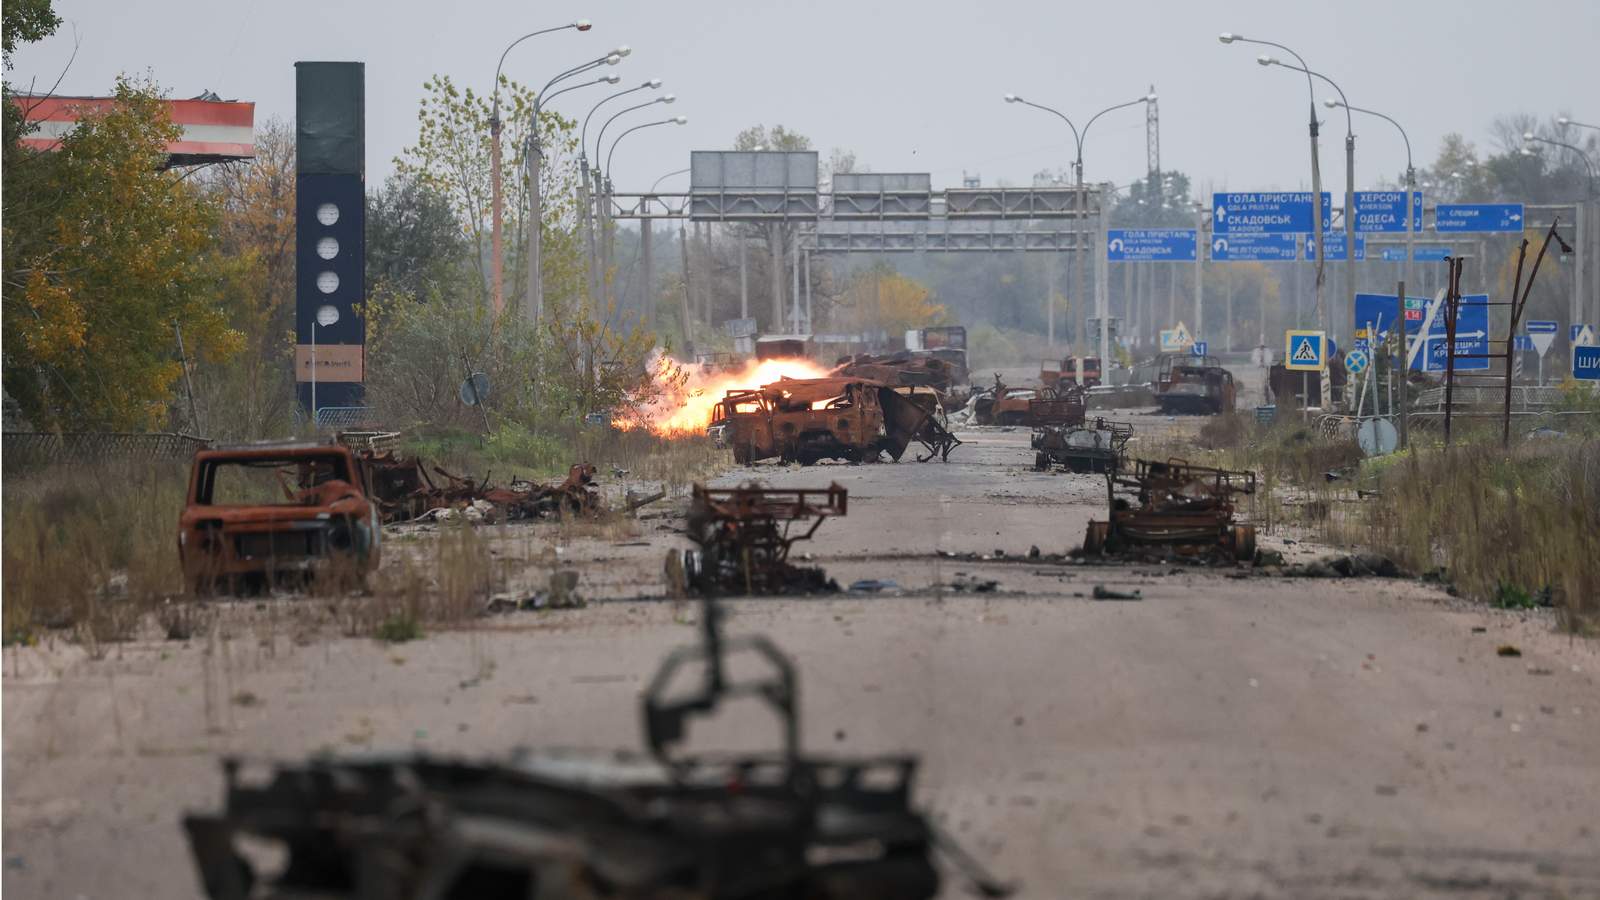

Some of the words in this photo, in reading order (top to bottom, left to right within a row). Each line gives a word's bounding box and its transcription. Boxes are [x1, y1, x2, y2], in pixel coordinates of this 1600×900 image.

[1227, 194, 1256, 203] ГОЛА
[1360, 193, 1401, 202] ХЕРСОН
[1227, 215, 1291, 225] СКАДОВСЬК
[1360, 214, 1396, 225] ОДЕСА
